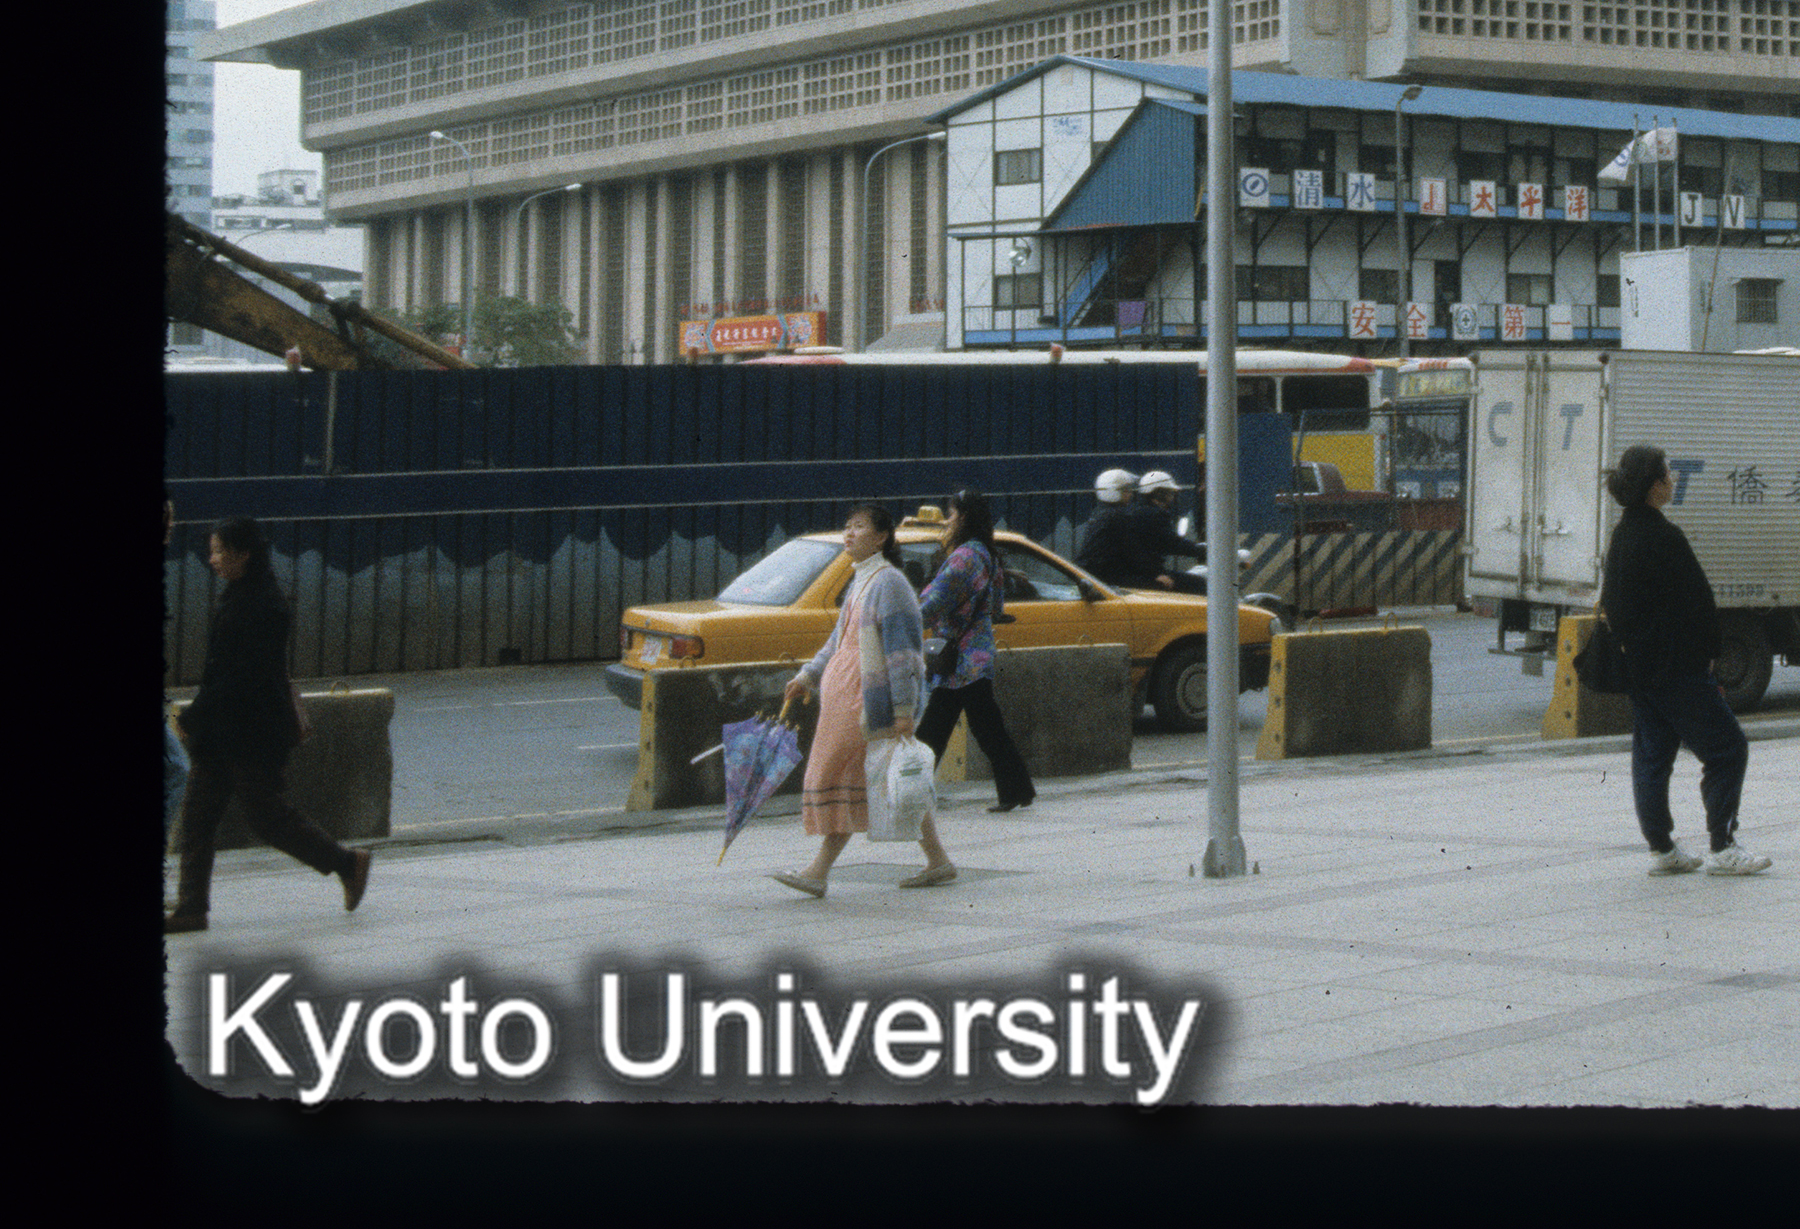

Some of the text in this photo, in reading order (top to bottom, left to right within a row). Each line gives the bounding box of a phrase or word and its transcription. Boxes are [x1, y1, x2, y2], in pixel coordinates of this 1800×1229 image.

[1297, 171, 1375, 209] 清水
[1470, 184, 1588, 220] 太平洋
